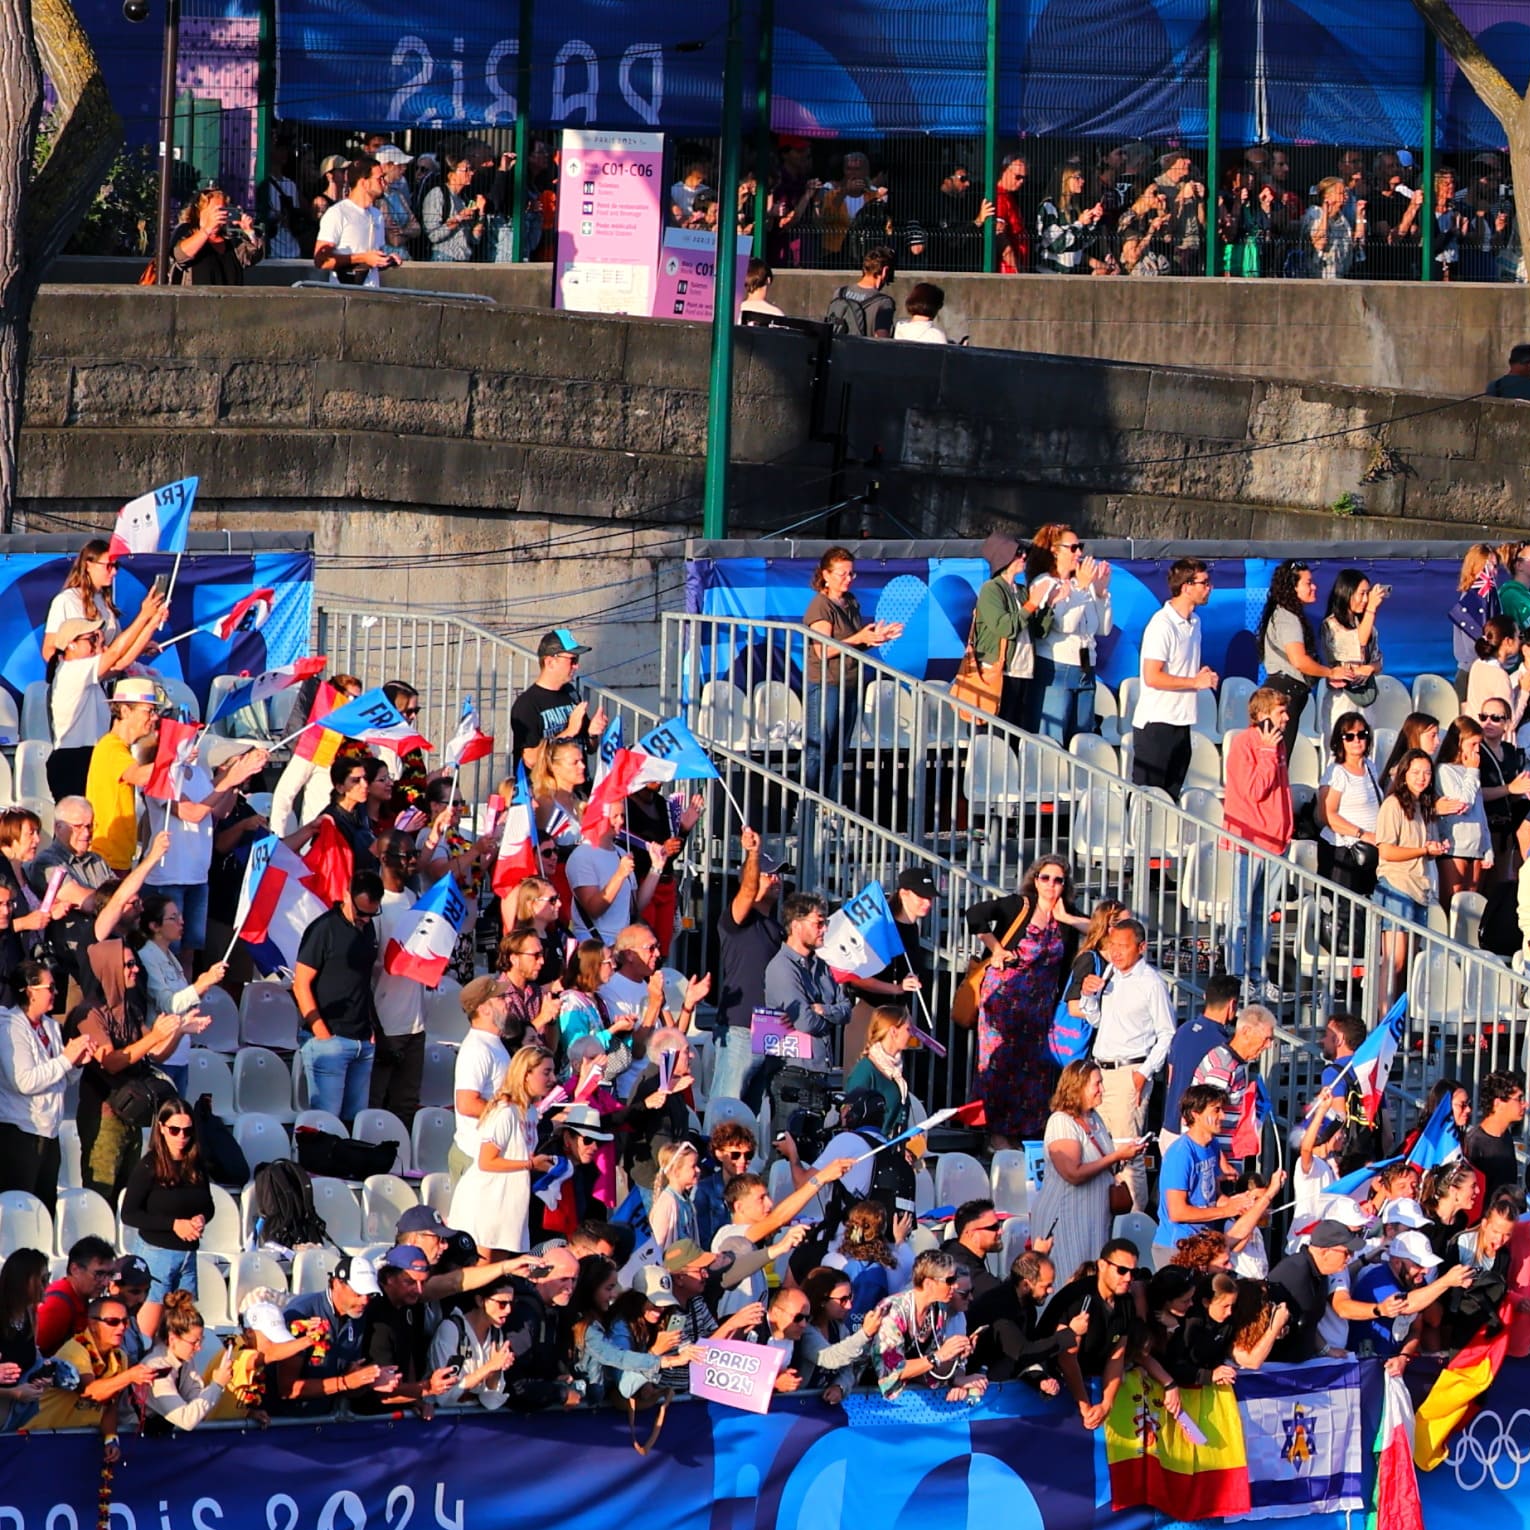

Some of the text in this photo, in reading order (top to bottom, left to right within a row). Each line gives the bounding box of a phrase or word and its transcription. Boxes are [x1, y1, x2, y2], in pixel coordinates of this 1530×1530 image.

[602, 162, 653, 178] C01-C06
[709, 1351, 760, 1374] PARIS
[705, 1370, 753, 1394] 2024
